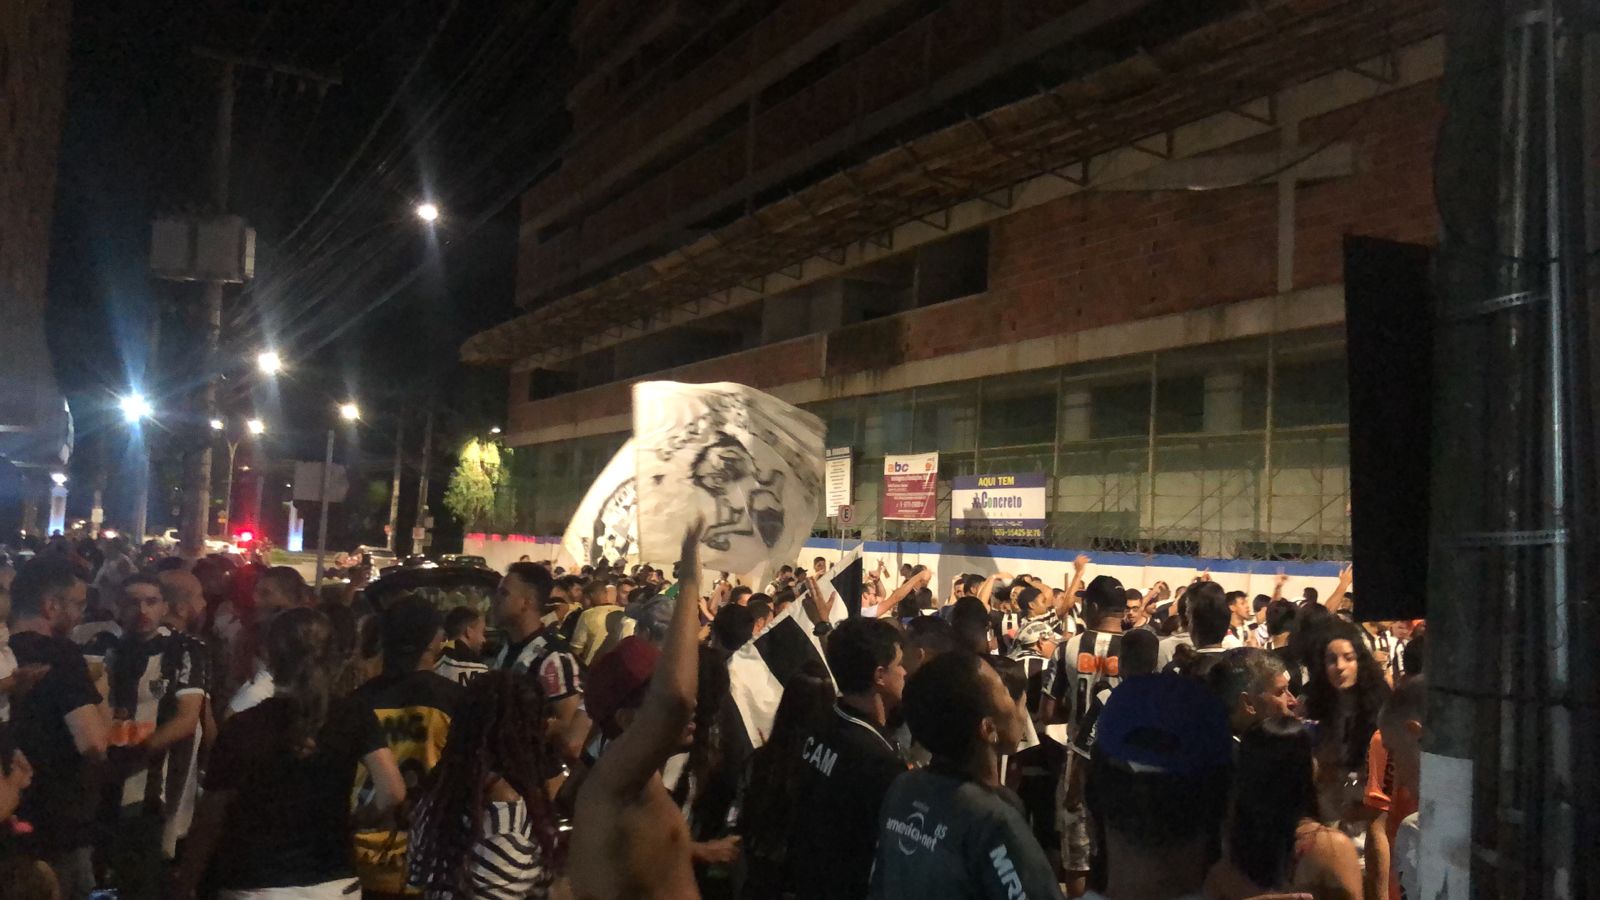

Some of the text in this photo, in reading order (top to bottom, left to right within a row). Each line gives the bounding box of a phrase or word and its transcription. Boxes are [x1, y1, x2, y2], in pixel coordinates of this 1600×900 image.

[887, 461, 910, 473] abc
[978, 475, 1015, 487] AQUI TEM
[981, 491, 1023, 509] Concreto
[802, 736, 839, 777] CAM
